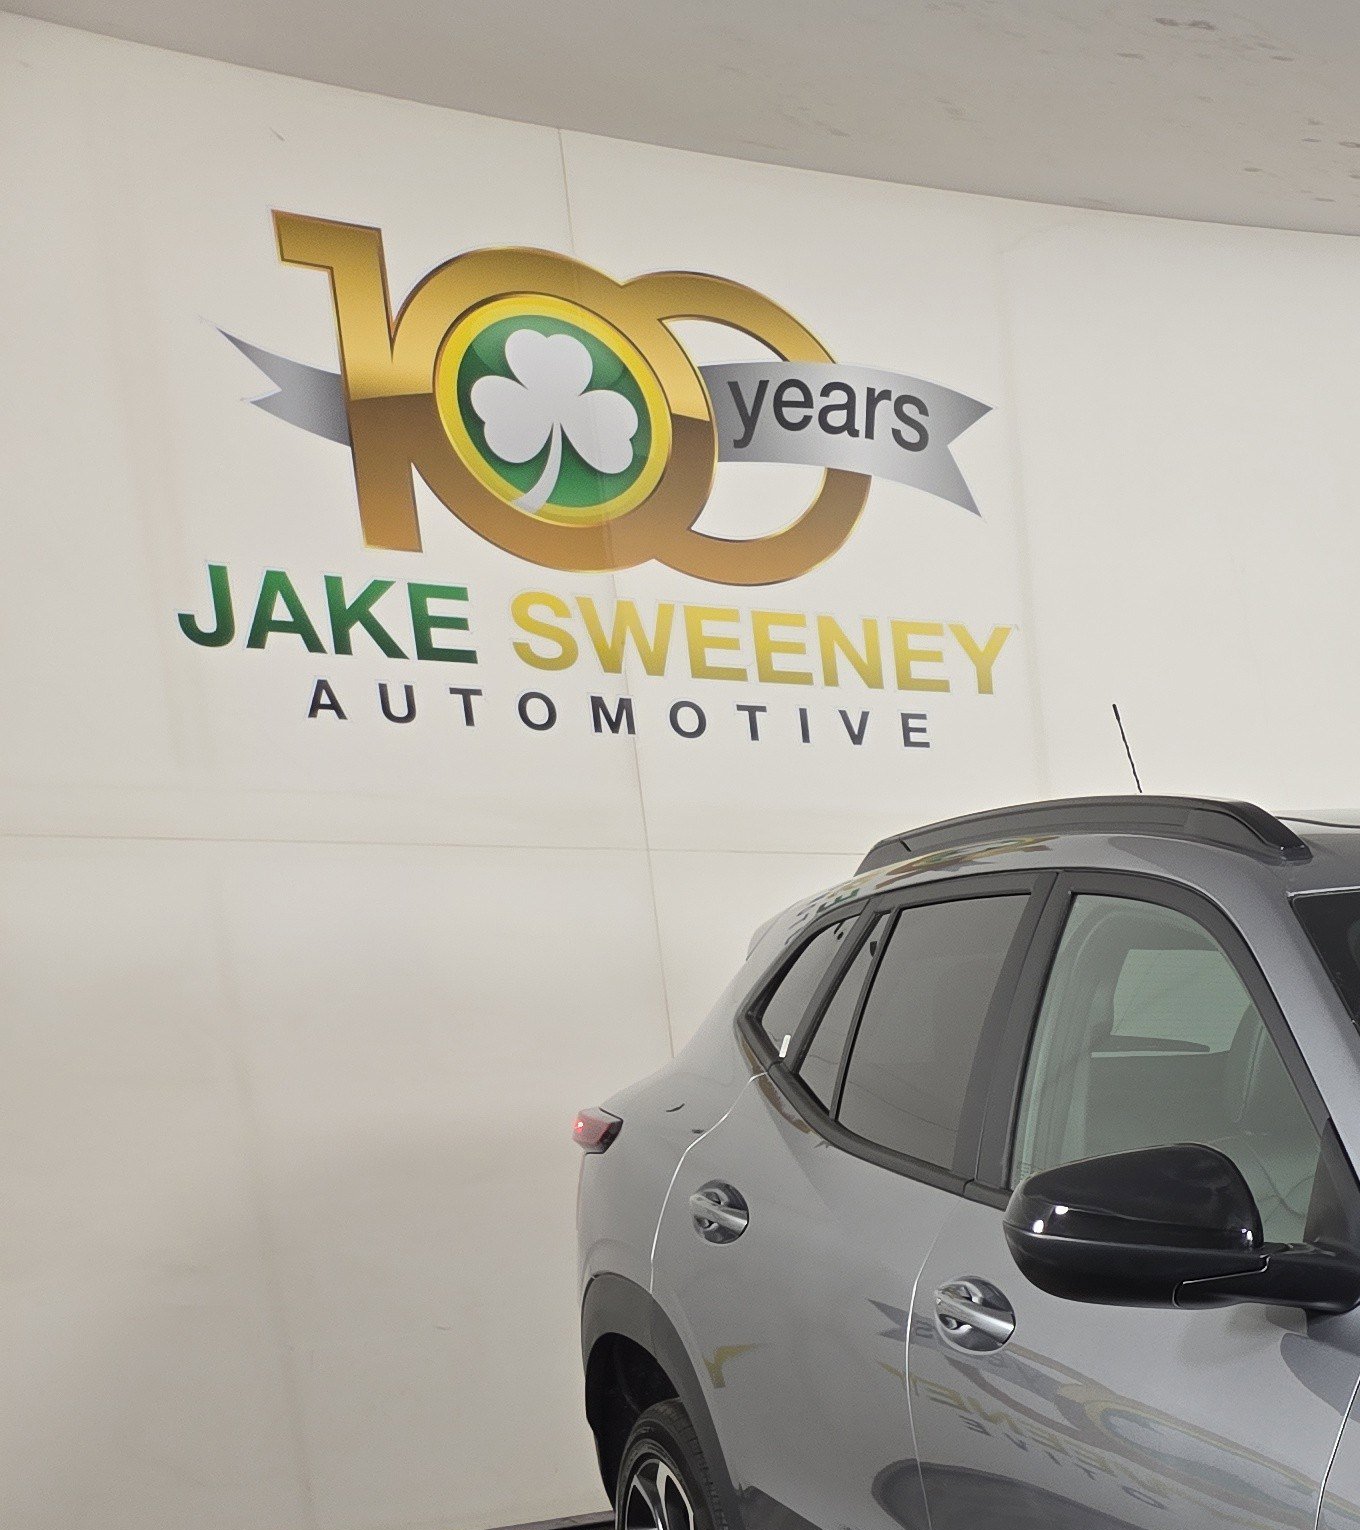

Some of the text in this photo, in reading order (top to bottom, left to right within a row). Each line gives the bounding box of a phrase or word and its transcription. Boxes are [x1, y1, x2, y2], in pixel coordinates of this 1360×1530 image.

[270, 208, 929, 587] 100 years
[177, 564, 1014, 695] JAKE SWEENEY
[308, 678, 931, 750] AUTOMOTIVE
